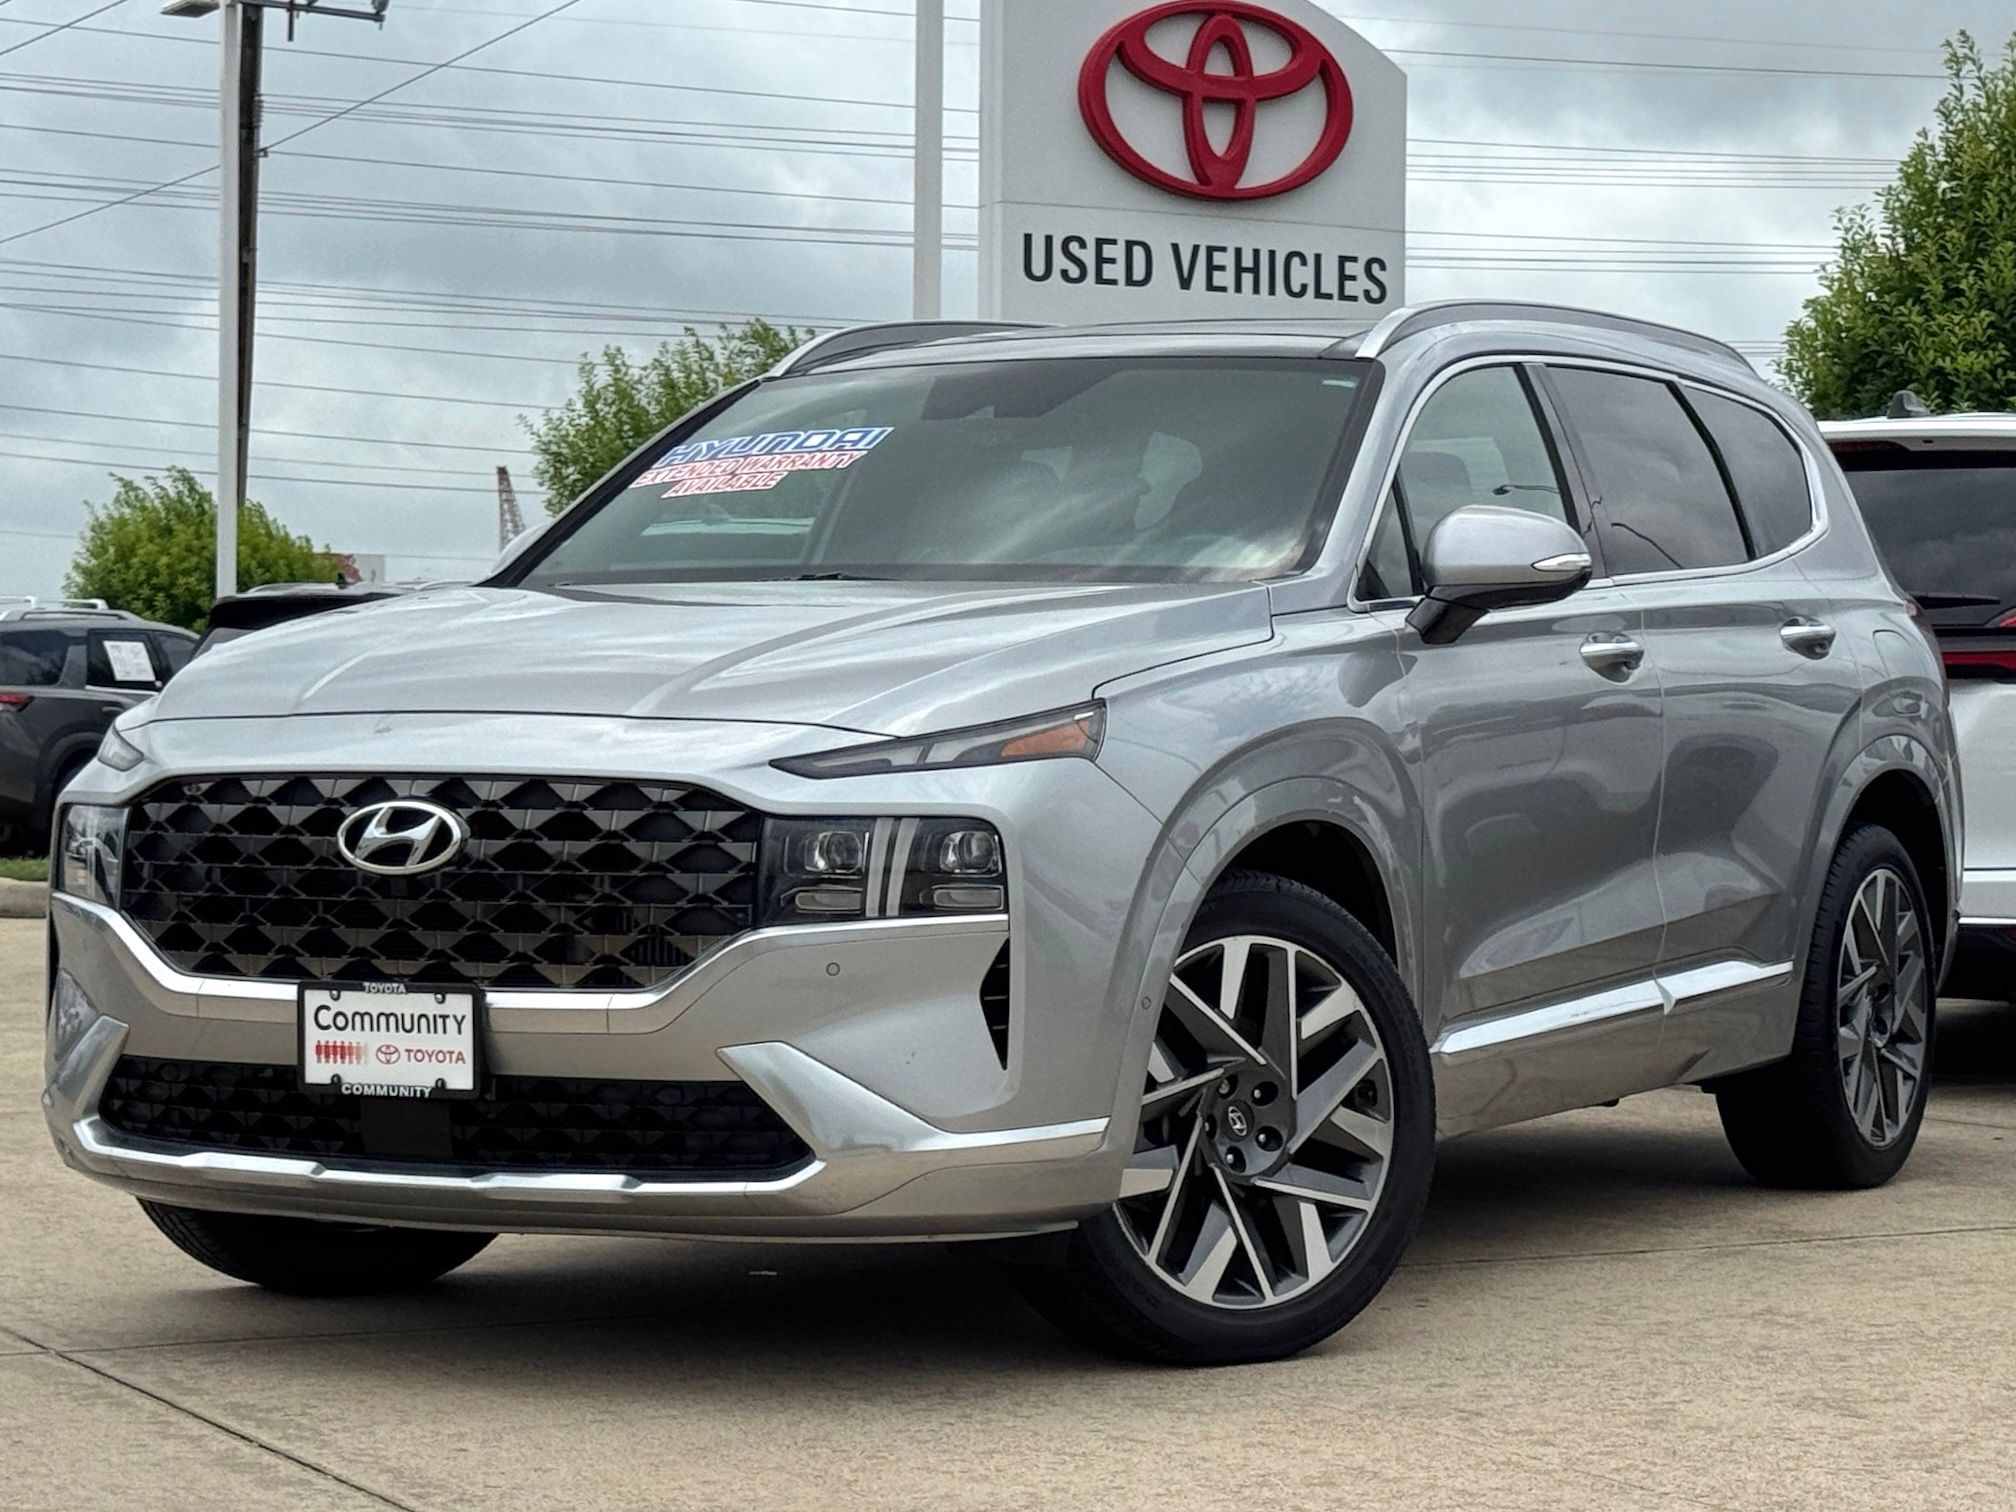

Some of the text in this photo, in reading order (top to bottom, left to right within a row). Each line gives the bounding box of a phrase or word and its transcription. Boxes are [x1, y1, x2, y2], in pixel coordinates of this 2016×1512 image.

[1023, 233, 1387, 304] USED VEHICLES
[651, 427, 894, 469] HYUNDAI
[632, 451, 866, 487] EXTENDED WARRANTY
[665, 471, 787, 497] AVAILABLE
[363, 982, 407, 994] TOYOTA
[404, 1048, 466, 1065] TOYOTA
[341, 1082, 433, 1099] COMMUNITY
